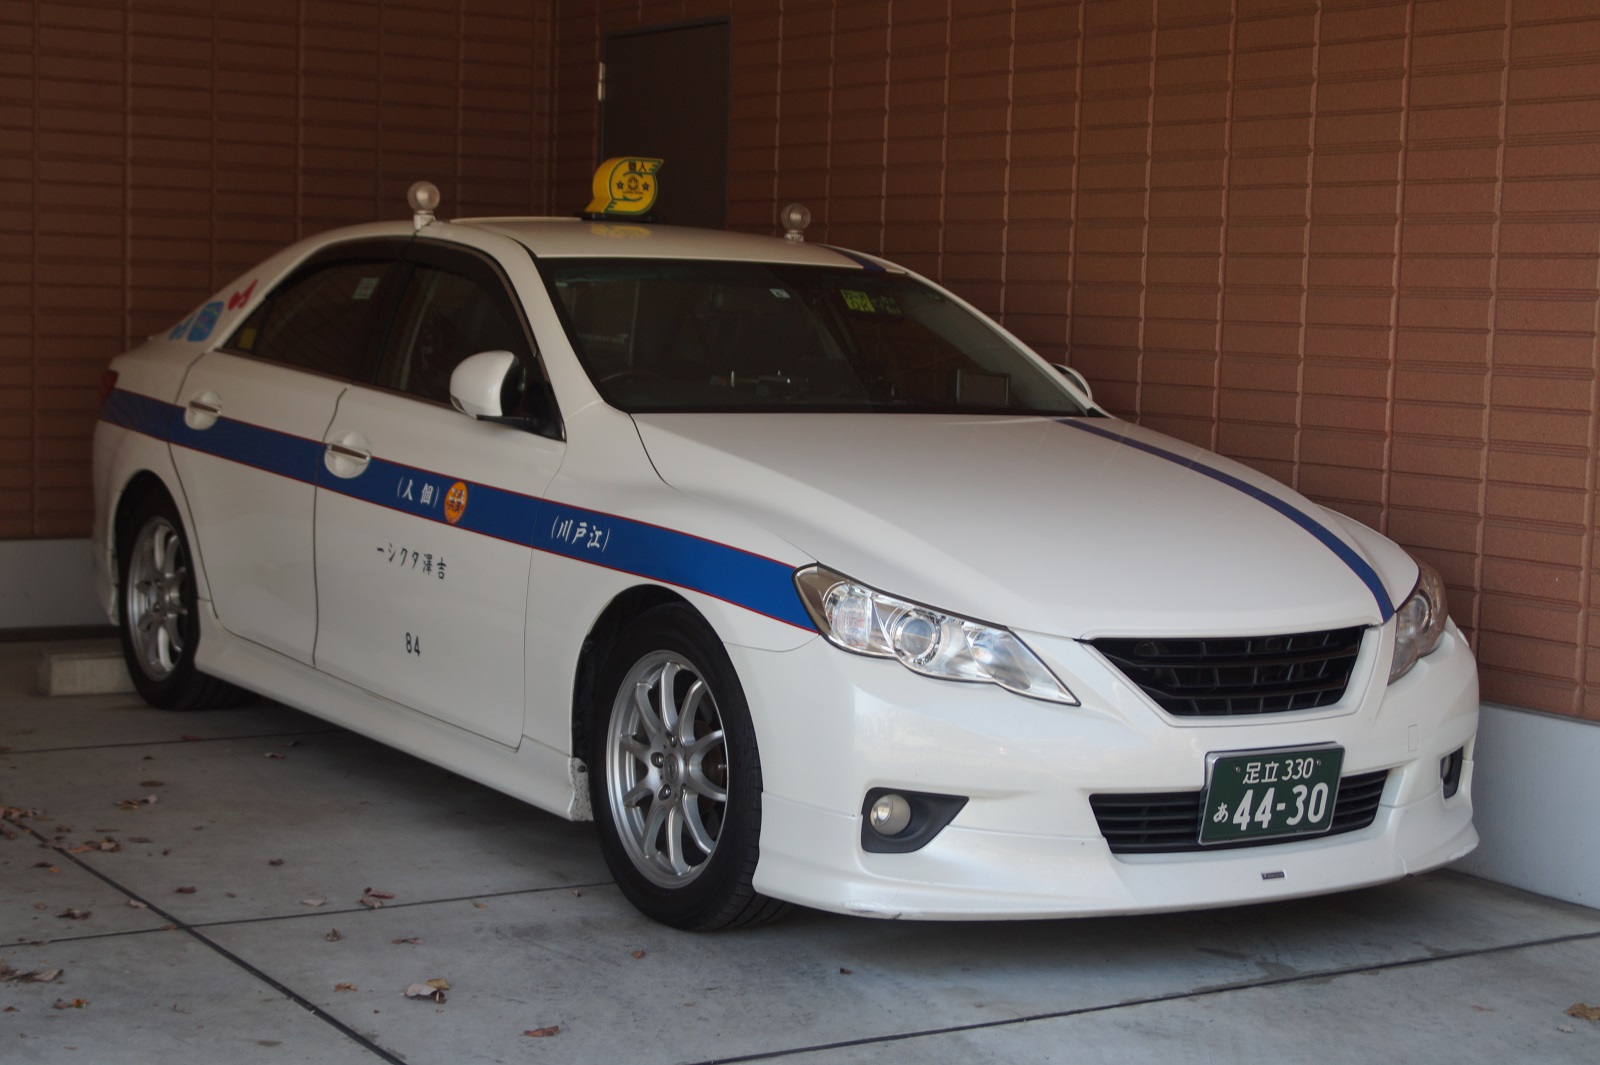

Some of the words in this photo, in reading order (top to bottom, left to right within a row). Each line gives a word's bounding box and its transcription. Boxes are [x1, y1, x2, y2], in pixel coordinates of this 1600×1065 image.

[405, 632, 421, 656] 84
[1242, 761, 1279, 784] 足立
[1281, 757, 1314, 781] 330
[1213, 802, 1229, 823] あ
[1232, 782, 1329, 831] 44-30
